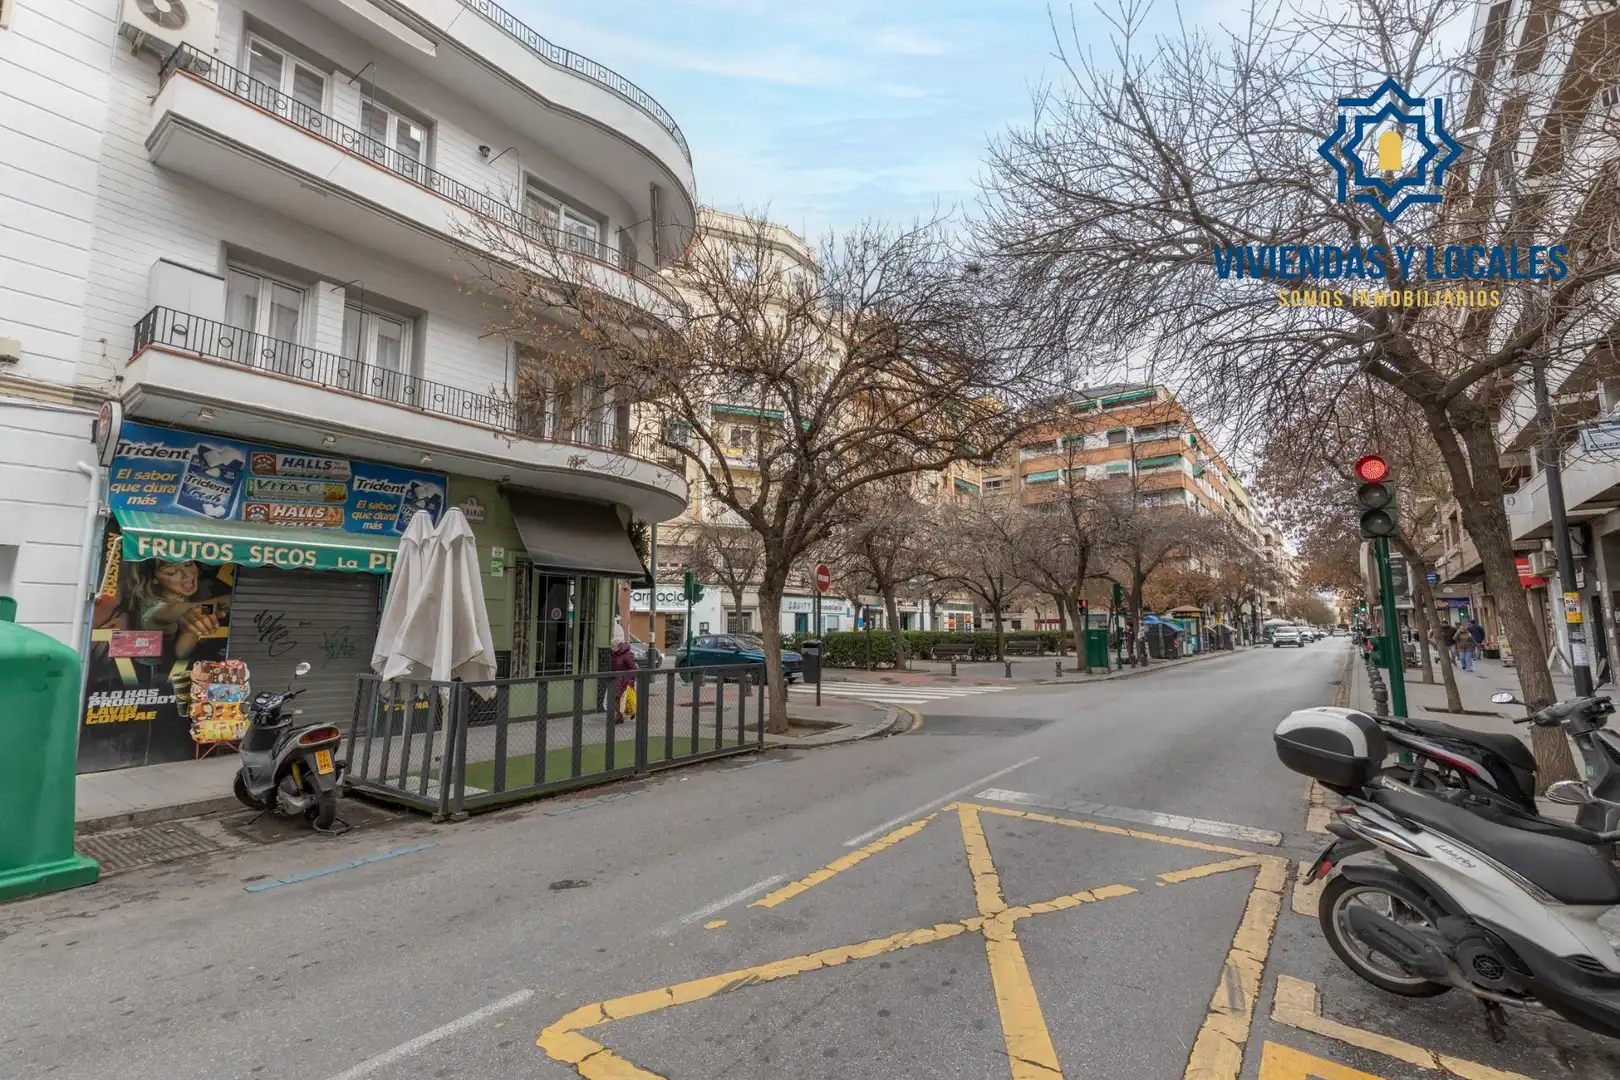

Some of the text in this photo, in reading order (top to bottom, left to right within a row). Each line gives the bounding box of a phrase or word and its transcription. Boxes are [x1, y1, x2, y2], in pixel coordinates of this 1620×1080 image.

[116, 442, 190, 460] Trident
[281, 458, 333, 470] HALLS
[116, 469, 177, 481] El sabor
[110, 482, 177, 494] que dura
[185, 473, 231, 494] Trident
[256, 480, 318, 493] VITA-C
[356, 478, 406, 494] Trident
[127, 494, 157, 506] más
[356, 500, 365, 509] El
[369, 501, 396, 511] sabor
[273, 505, 326, 519] HALLS
[352, 511, 397, 521] que dura
[362, 520, 383, 530] más
[138, 536, 233, 561] FRUTOS
[248, 545, 317, 567] SECOS
[124, 689, 159, 698] HAS
[88, 695, 177, 708] PROBADO?
[86, 711, 157, 725] COMPAE
